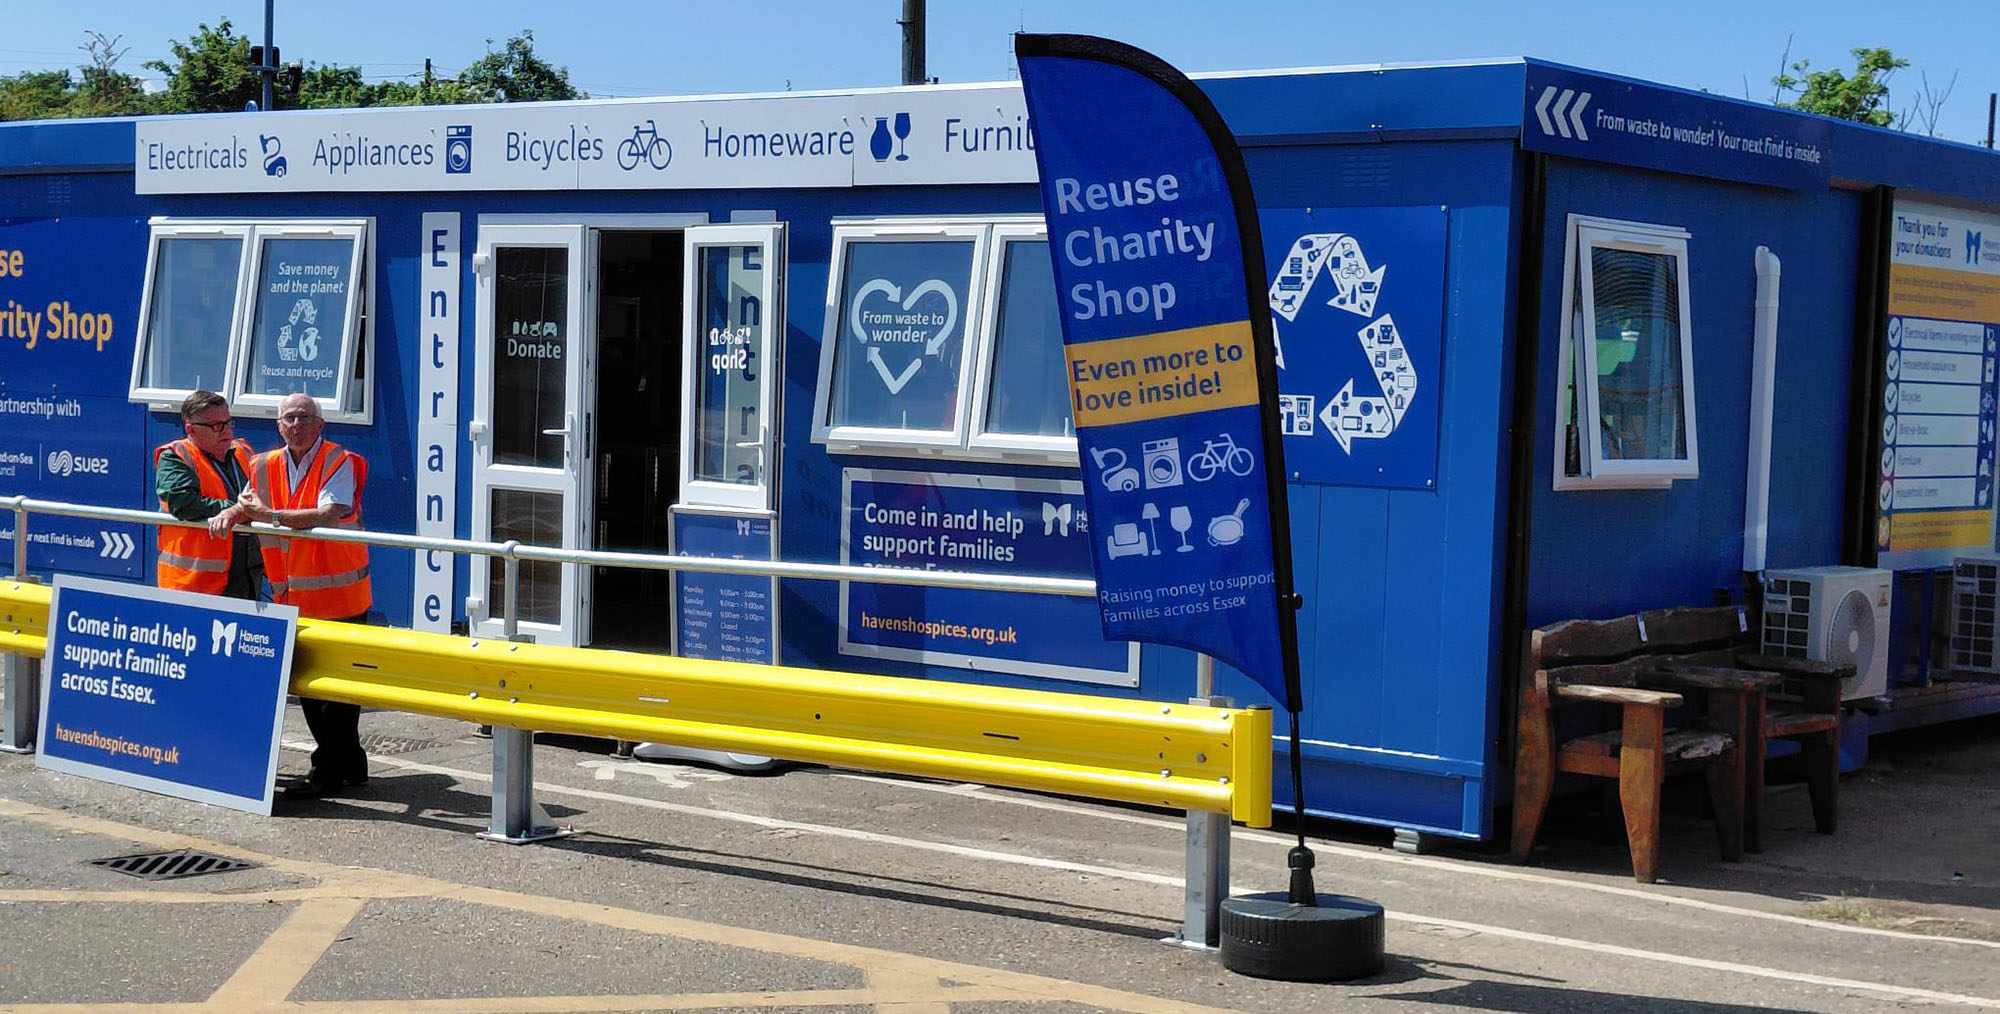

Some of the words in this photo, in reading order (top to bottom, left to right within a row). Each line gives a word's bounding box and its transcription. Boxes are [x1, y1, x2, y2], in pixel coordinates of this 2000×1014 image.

[506, 126, 604, 171] Bicycles
[704, 126, 855, 158] Homeware
[1596, 108, 1625, 132] From
[1627, 119, 1658, 137] waste
[1660, 121, 1671, 140] to
[1673, 126, 1714, 147] wonder!
[1717, 130, 1742, 150] Your
[1742, 138, 1763, 154] next
[1764, 137, 1784, 158] find
[1785, 140, 1793, 159] is
[1794, 142, 1821, 163] inside
[148, 136, 247, 170] Electricals
[313, 135, 434, 175] Appliances
[1055, 173, 1180, 215] Reuse
[1064, 217, 1215, 267] Charity
[1897, 216, 1921, 234] Thank
[1922, 224, 1936, 240] you
[1938, 221, 1949, 238] for
[1895, 241, 1914, 257] your
[1914, 241, 1952, 259] donations
[278, 262, 303, 276] Save
[304, 264, 340, 279] money
[270, 280, 290, 293] and
[291, 280, 309, 293] the
[309, 280, 345, 297] planet
[1071, 280, 1177, 321] Shop
[46, 301, 113, 352] Shop
[862, 311, 892, 324] From
[894, 313, 929, 325] waste
[931, 313, 945, 325] to
[872, 326, 928, 343] wonder
[507, 338, 562, 359] Donate
[1072, 359, 1137, 383] Even
[1143, 348, 1209, 374] more
[1214, 342, 1243, 364] to
[261, 364, 286, 377] Reuse
[286, 365, 303, 377] and
[303, 366, 334, 380] recycle
[56, 399, 81, 417] with
[1076, 387, 1132, 412] love
[1138, 371, 1222, 405] inside!
[424, 229, 448, 622] Entrance
[864, 502, 917, 527] Come
[921, 506, 938, 528] in
[942, 508, 978, 531] and
[983, 509, 1025, 540] help
[33, 533, 50, 544] next
[50, 532, 65, 545] find
[66, 534, 72, 546] is
[72, 535, 95, 548] inside
[863, 534, 936, 559] support
[939, 534, 1015, 563] families
[1100, 588, 1153, 604] Raising
[1156, 581, 1206, 598] money
[1209, 578, 1225, 591] to
[1226, 571, 1276, 590] support
[1103, 606, 1160, 623] families
[1163, 600, 1210, 617] across
[1213, 595, 1247, 610] Essex
[67, 610, 110, 639] Come
[112, 616, 127, 641] in
[130, 622, 161, 646] and
[162, 624, 197, 657] help
[239, 629, 270, 645] Havens
[861, 611, 1017, 646] havenshospices.org.uk
[63, 643, 122, 670] support
[125, 648, 187, 680] families
[238, 642, 276, 658] Hospices
[61, 673, 108, 696] across
[111, 676, 156, 705] Essex.
[55, 723, 180, 765] havenshospices.org.uk
